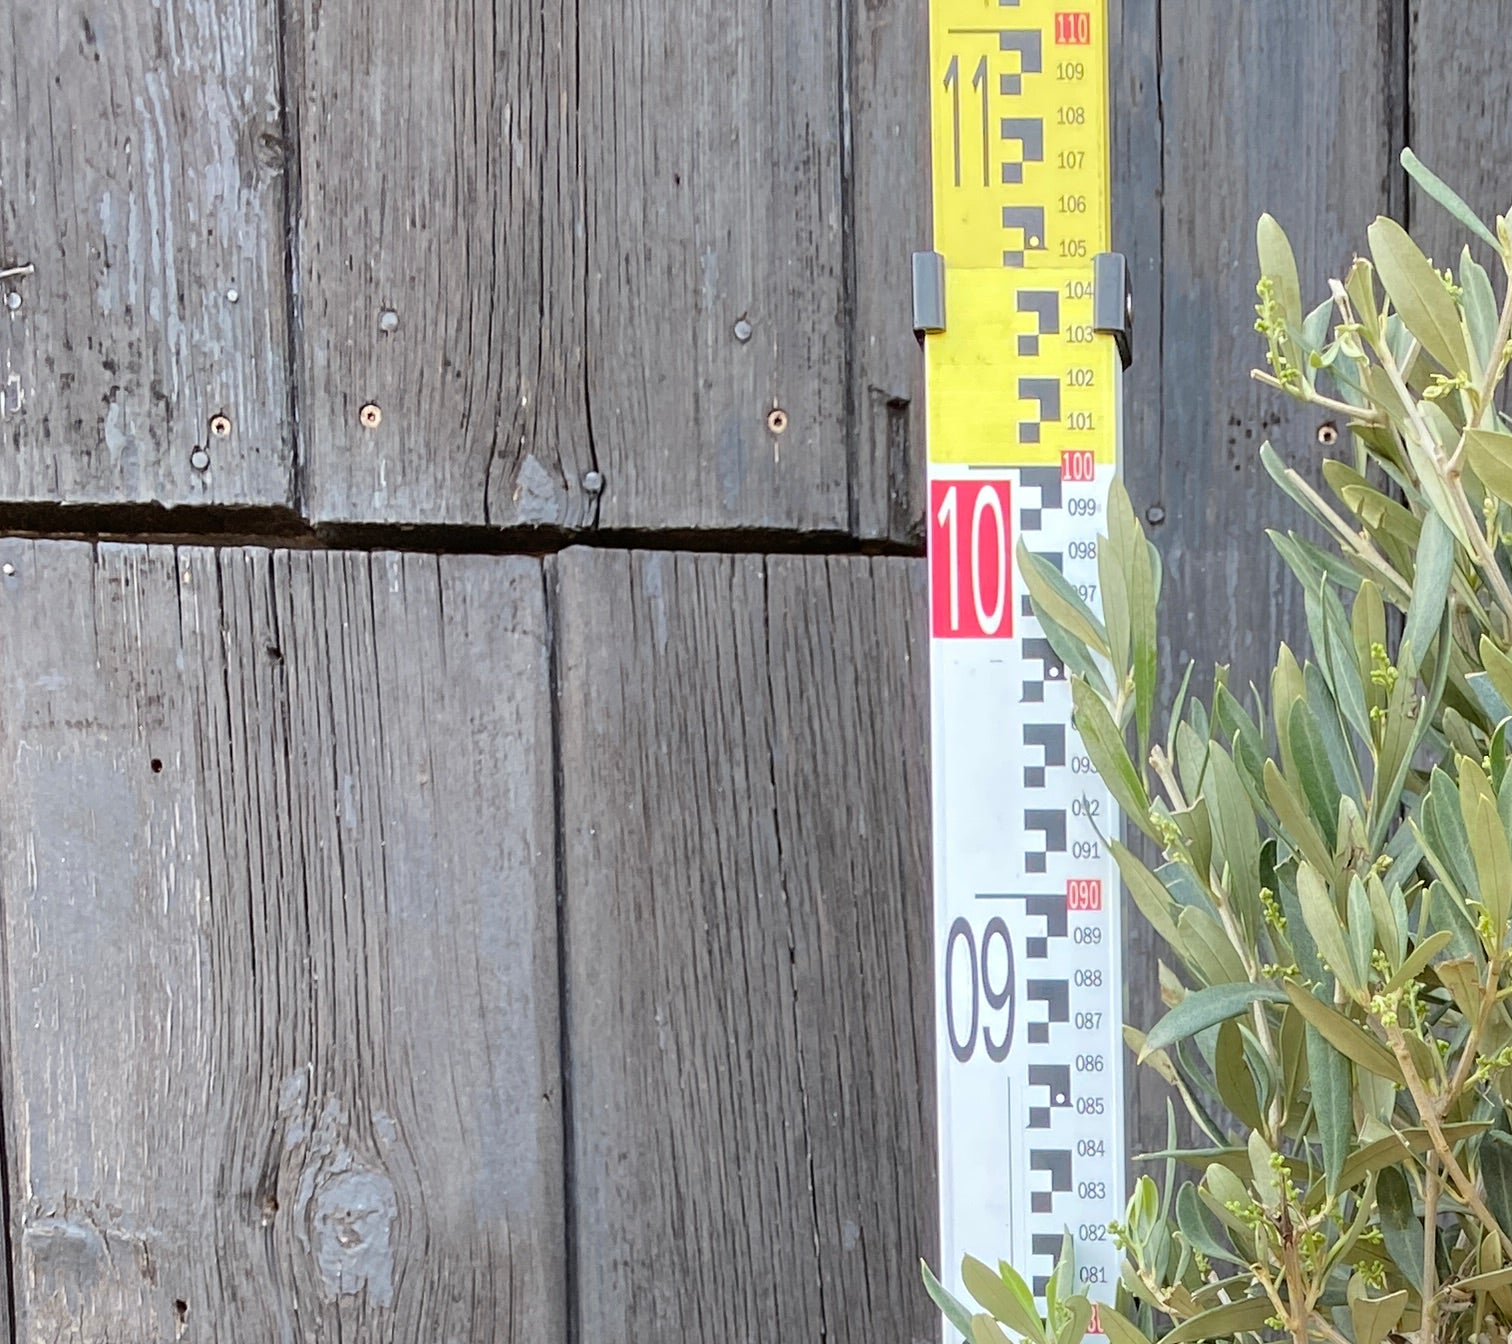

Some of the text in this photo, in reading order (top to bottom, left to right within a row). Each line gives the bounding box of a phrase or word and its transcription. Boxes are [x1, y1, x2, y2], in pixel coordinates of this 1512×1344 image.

[1057, 13, 1089, 43] 110
[1056, 62, 1085, 81] 109
[943, 55, 990, 187] 11
[1056, 106, 1086, 126] 108
[1057, 150, 1086, 170] 107
[1057, 194, 1087, 214] 106
[1058, 238, 1087, 258] 105
[1065, 280, 1095, 300] 104
[1065, 324, 1095, 344] 103
[1066, 368, 1095, 387] 102
[1066, 411, 1096, 431] 101
[1062, 453, 1093, 480] 100
[1067, 497, 1097, 517] 099
[937, 485, 1006, 635] 10
[1067, 540, 1097, 560] 098
[1071, 841, 1101, 860] 091
[1068, 883, 1100, 909] 090
[1073, 926, 1102, 945] 089
[1073, 968, 1103, 988] 088
[946, 916, 1015, 1063] 09
[1074, 1011, 1103, 1030] 087
[1075, 1054, 1105, 1073] 086
[1076, 1096, 1105, 1115] 085
[1076, 1139, 1106, 1158] 084
[1077, 1181, 1106, 1200] 083
[1078, 1223, 1107, 1242] 082
[1079, 1265, 1108, 1284] 081
